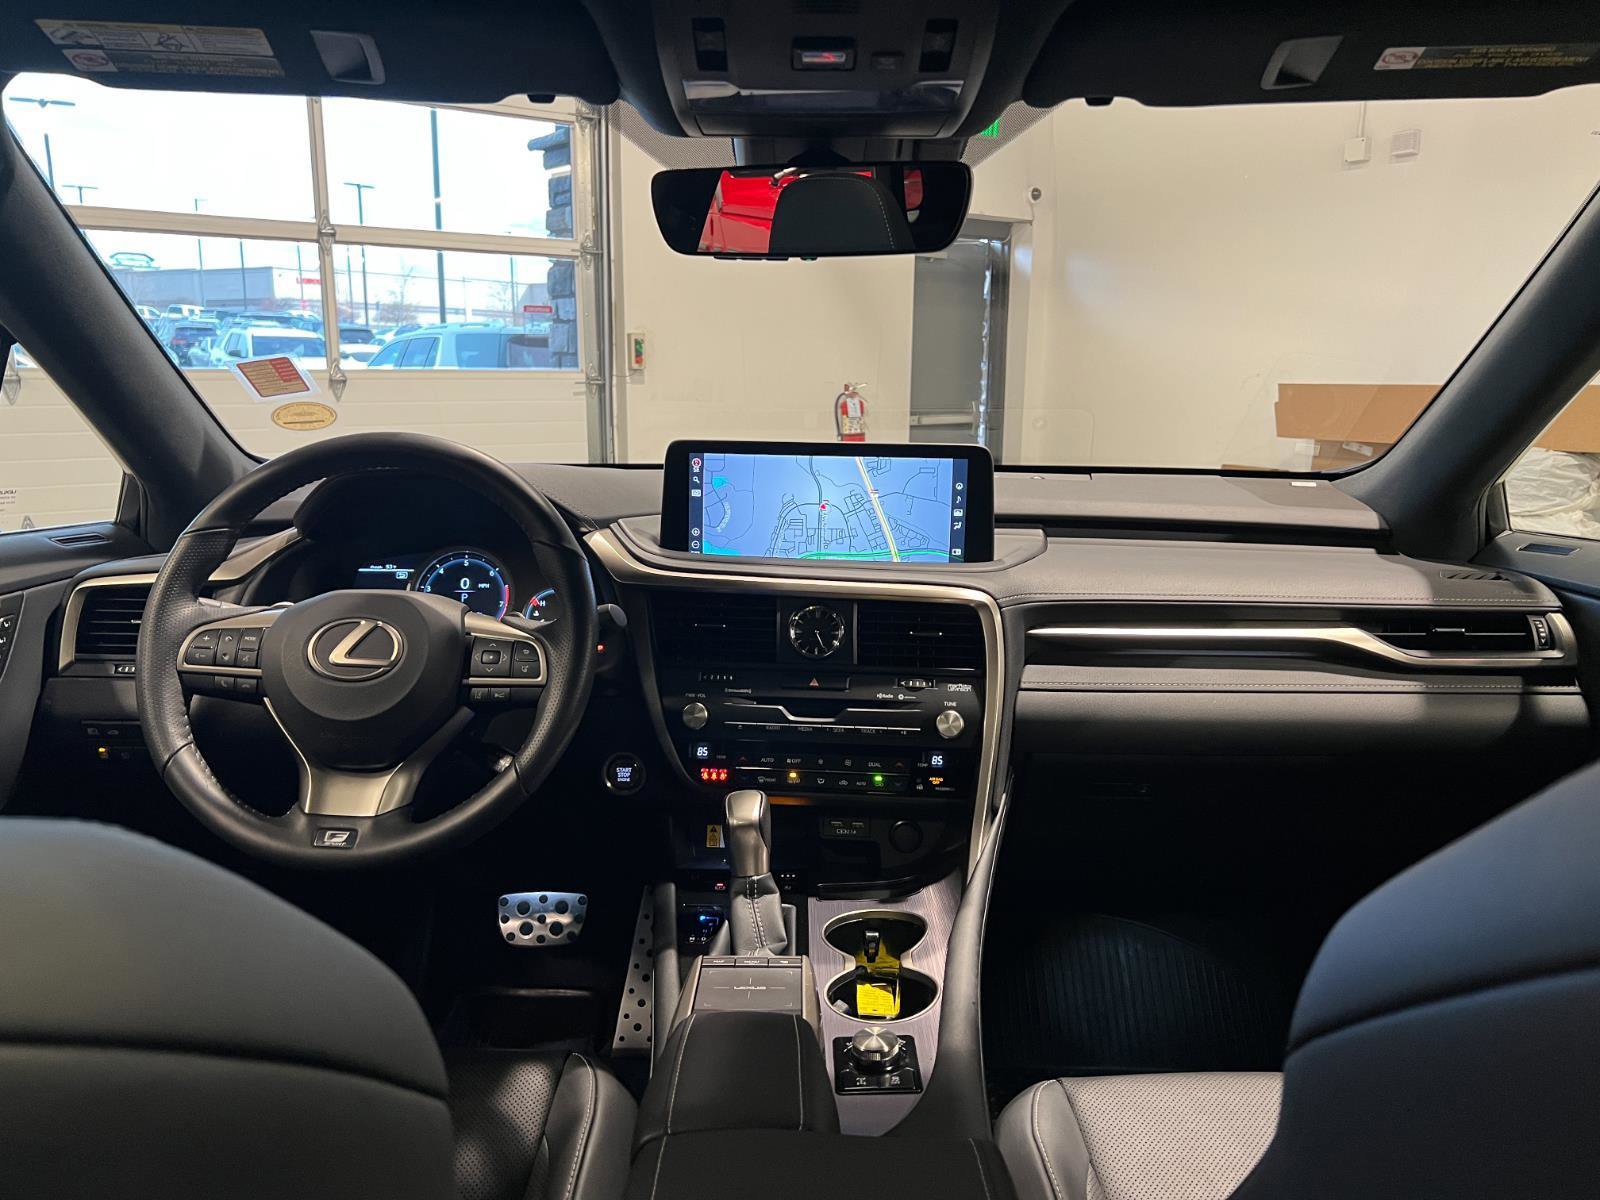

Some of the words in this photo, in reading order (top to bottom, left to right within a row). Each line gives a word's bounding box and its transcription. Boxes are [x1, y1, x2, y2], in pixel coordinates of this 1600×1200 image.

[460, 577, 470, 590] 0
[461, 593, 469, 603] P
[696, 746, 708, 757] 85
[931, 755, 944, 766] 85
